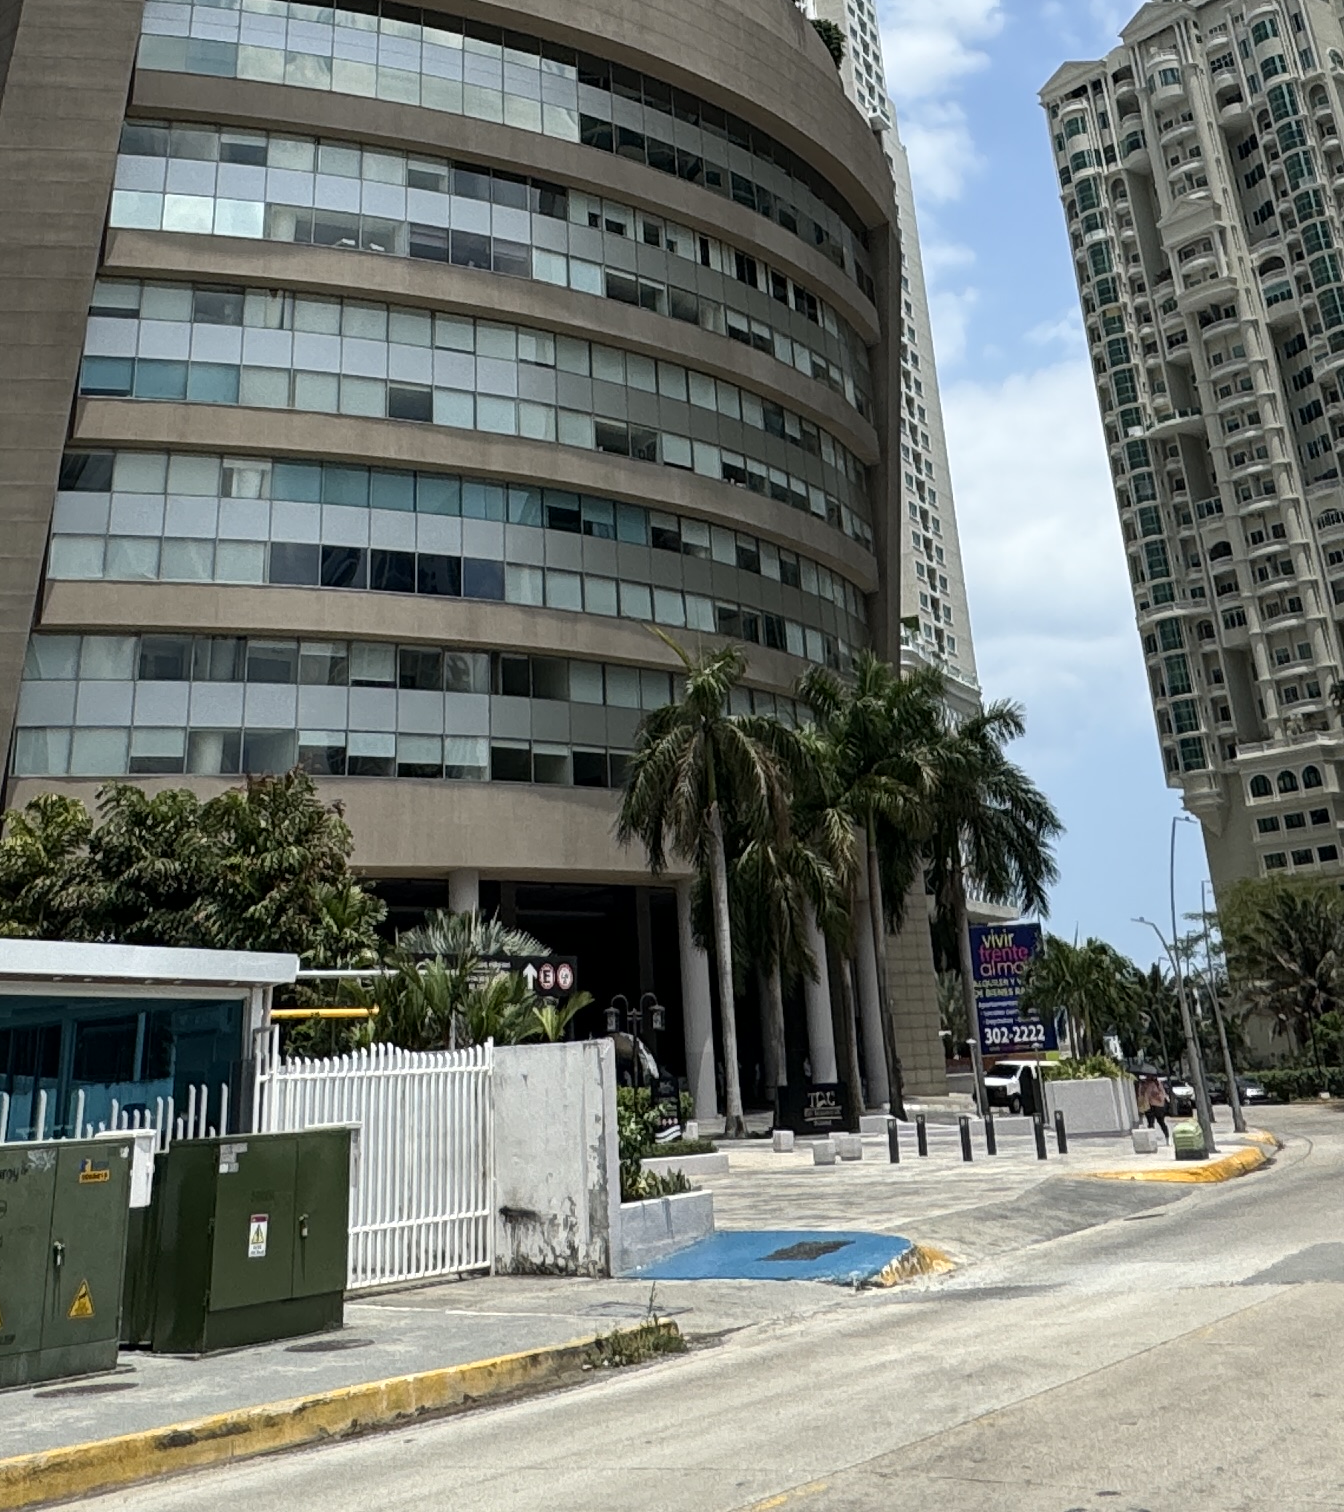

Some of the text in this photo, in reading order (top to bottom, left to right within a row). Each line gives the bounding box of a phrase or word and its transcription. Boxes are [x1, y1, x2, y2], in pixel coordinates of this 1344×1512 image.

[981, 929, 1014, 948] vivir
[978, 945, 1029, 962] frente
[984, 1024, 1046, 1045] 302-2222
